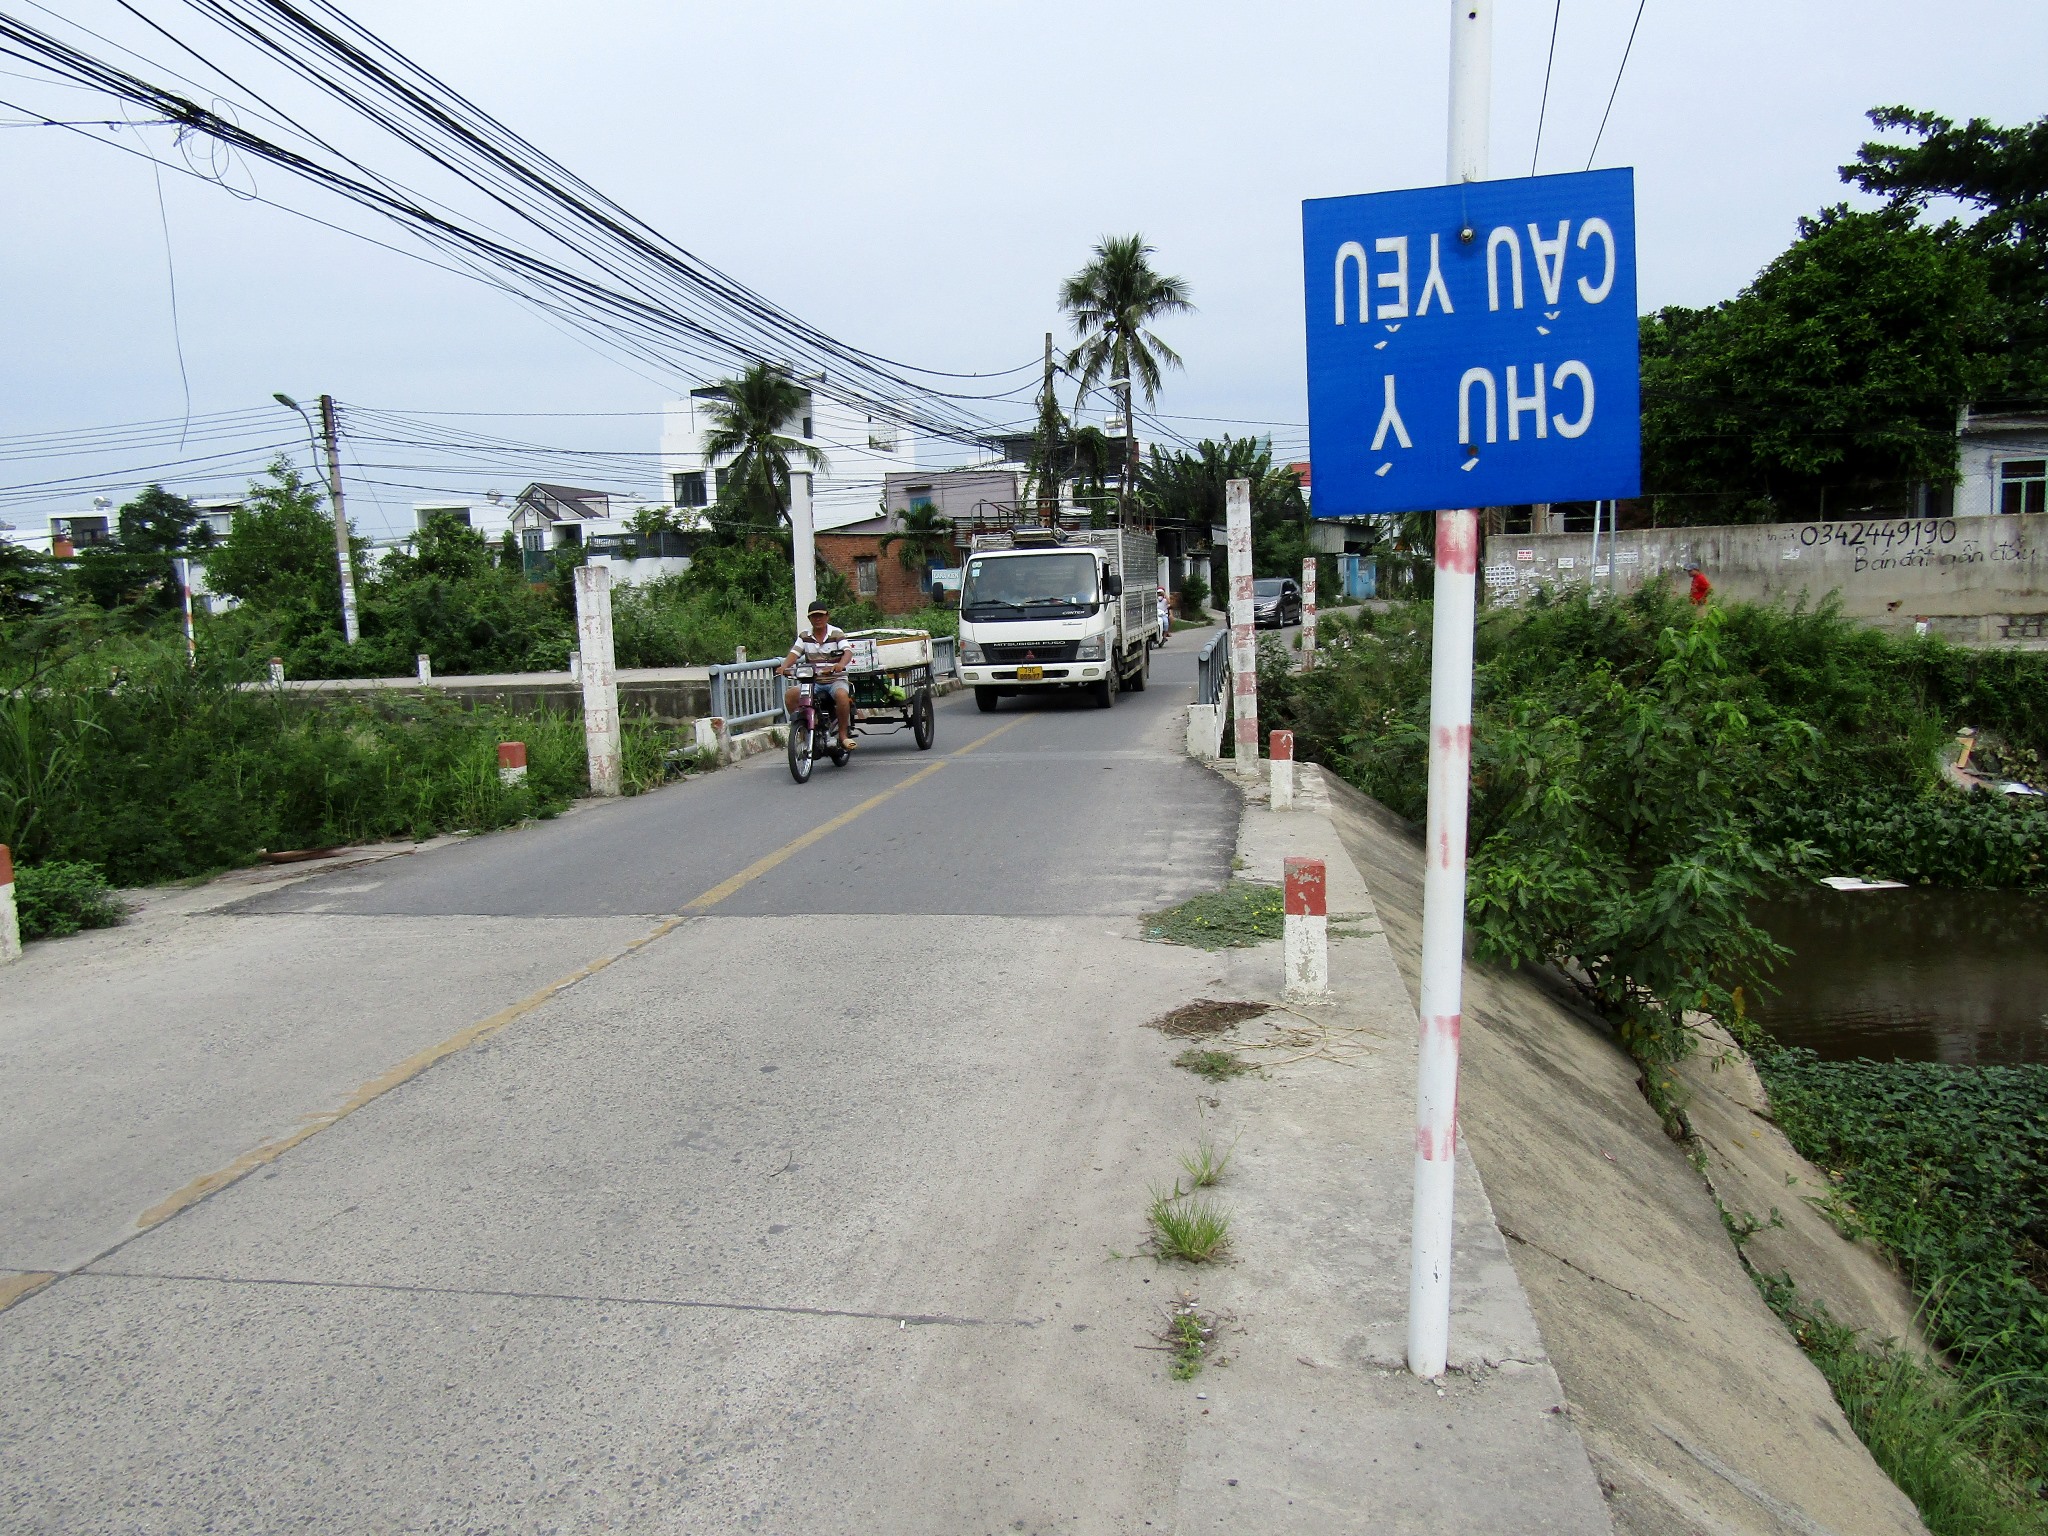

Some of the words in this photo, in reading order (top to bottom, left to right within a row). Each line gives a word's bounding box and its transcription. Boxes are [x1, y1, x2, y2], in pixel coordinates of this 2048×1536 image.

[1333, 232, 1455, 351] YẾU
[1486, 216, 1616, 336] CẦU
[1369, 373, 1414, 478] Ý
[1458, 359, 1596, 473] CHÚ
[1800, 519, 1957, 547] 0342449190
[1854, 545, 1896, 572] Bán
